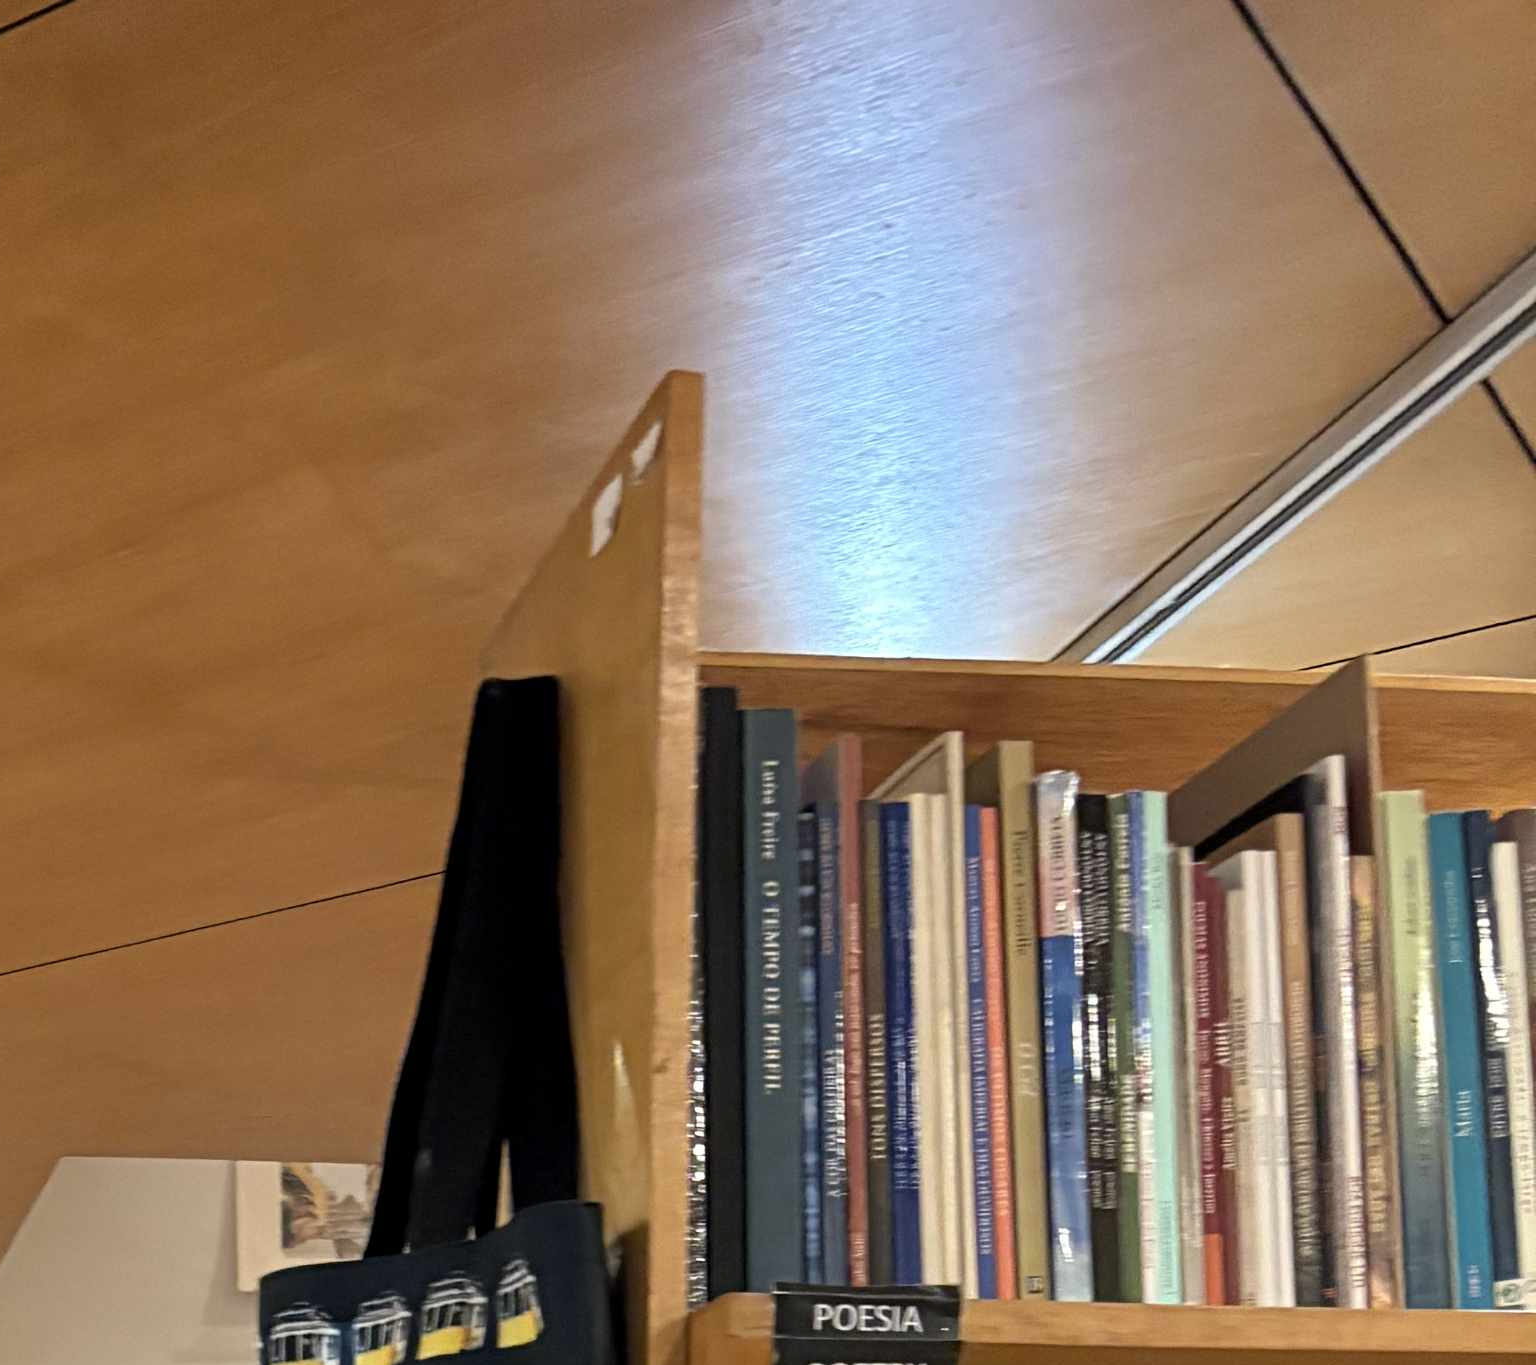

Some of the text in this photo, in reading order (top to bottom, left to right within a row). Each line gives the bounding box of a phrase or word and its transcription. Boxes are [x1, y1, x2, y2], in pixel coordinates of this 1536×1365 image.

[761, 813, 781, 860] Freire
[761, 882, 783, 1096] O TEMPO DE PERFIL
[812, 1304, 924, 1333] POESIA
